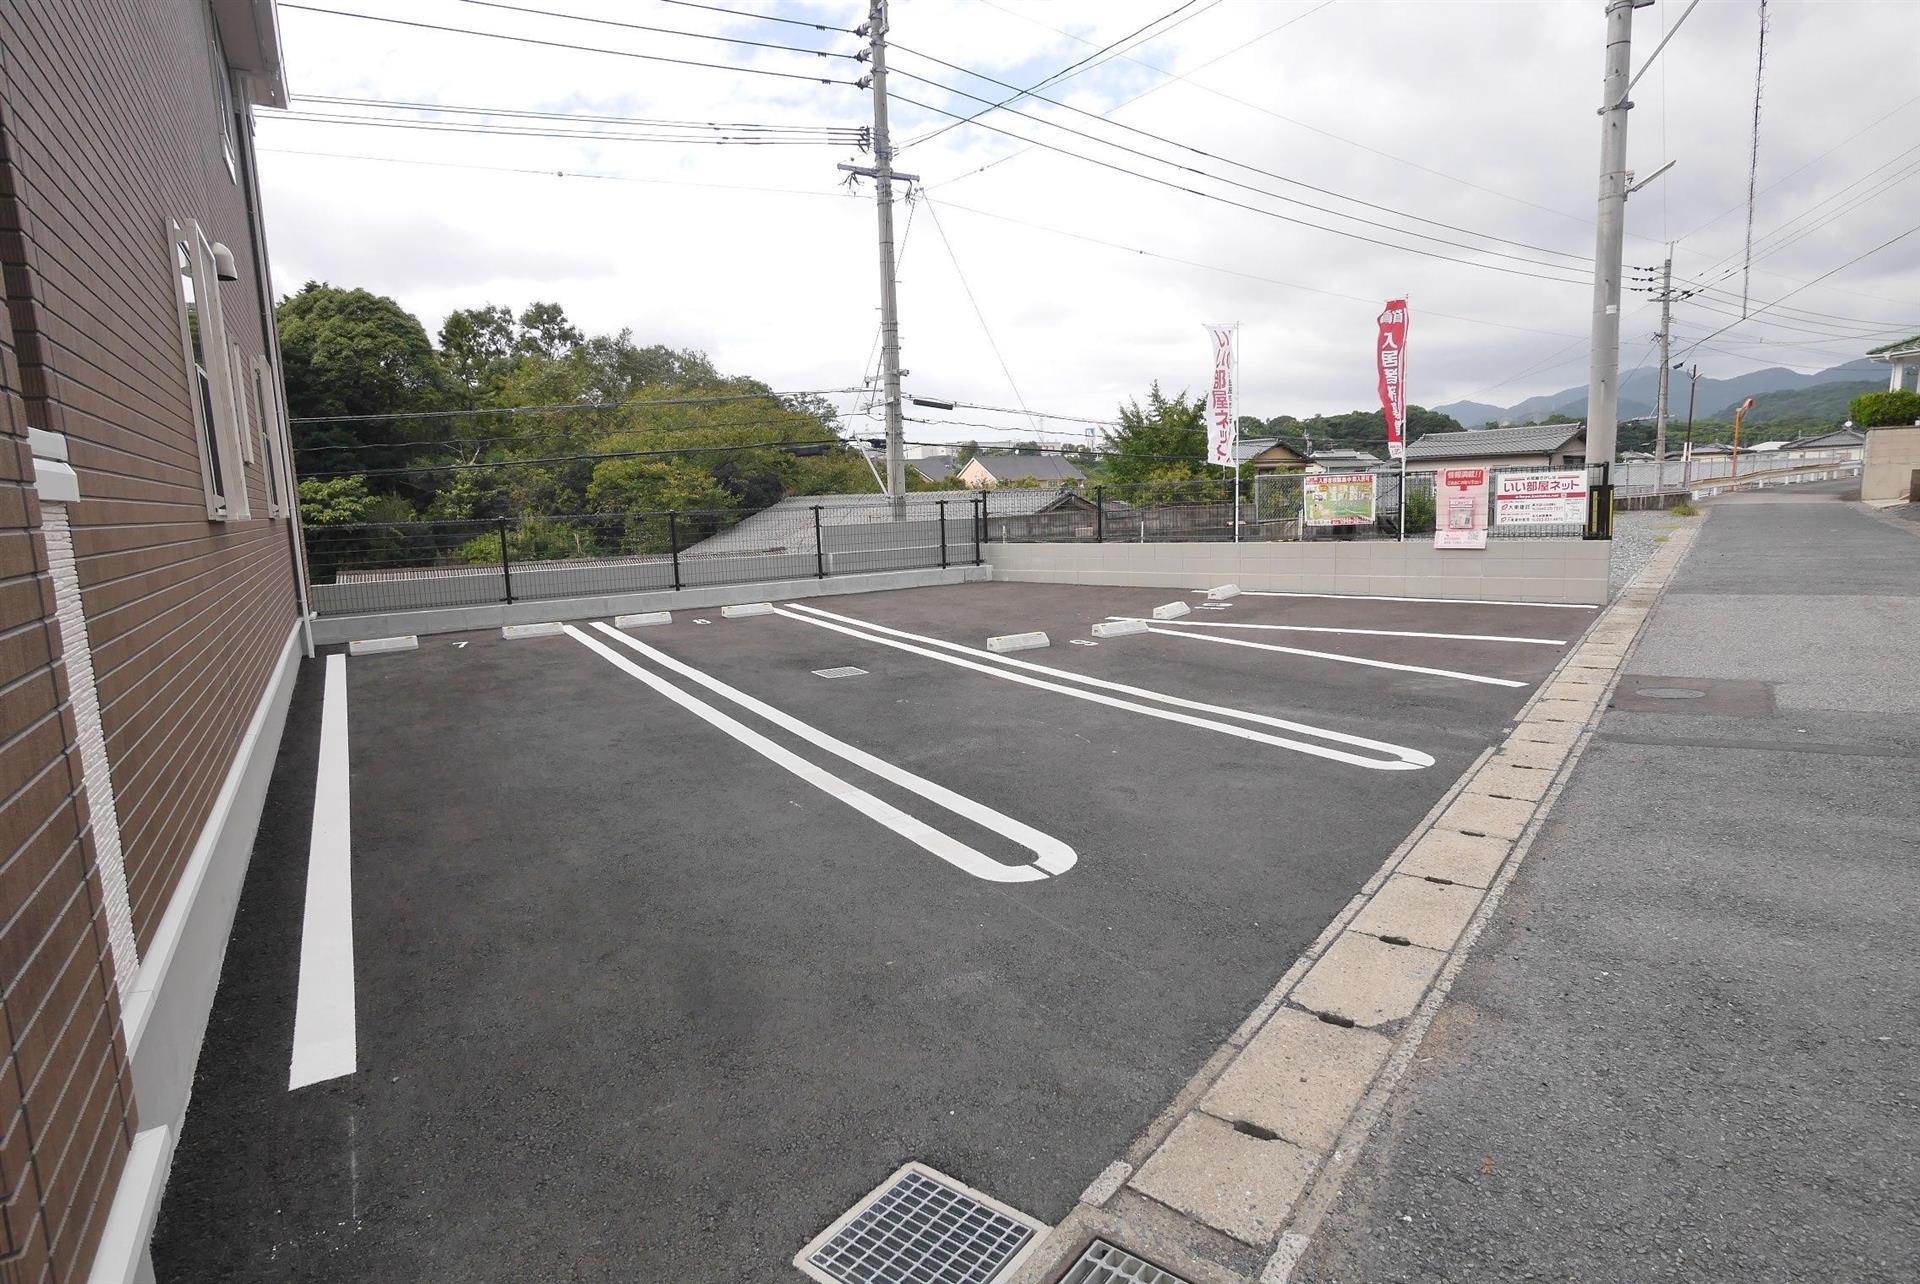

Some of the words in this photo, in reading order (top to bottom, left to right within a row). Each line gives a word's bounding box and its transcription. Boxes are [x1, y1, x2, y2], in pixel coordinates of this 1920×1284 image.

[1503, 479, 1580, 492] いい部屋ネット
[452, 641, 469, 649] 7
